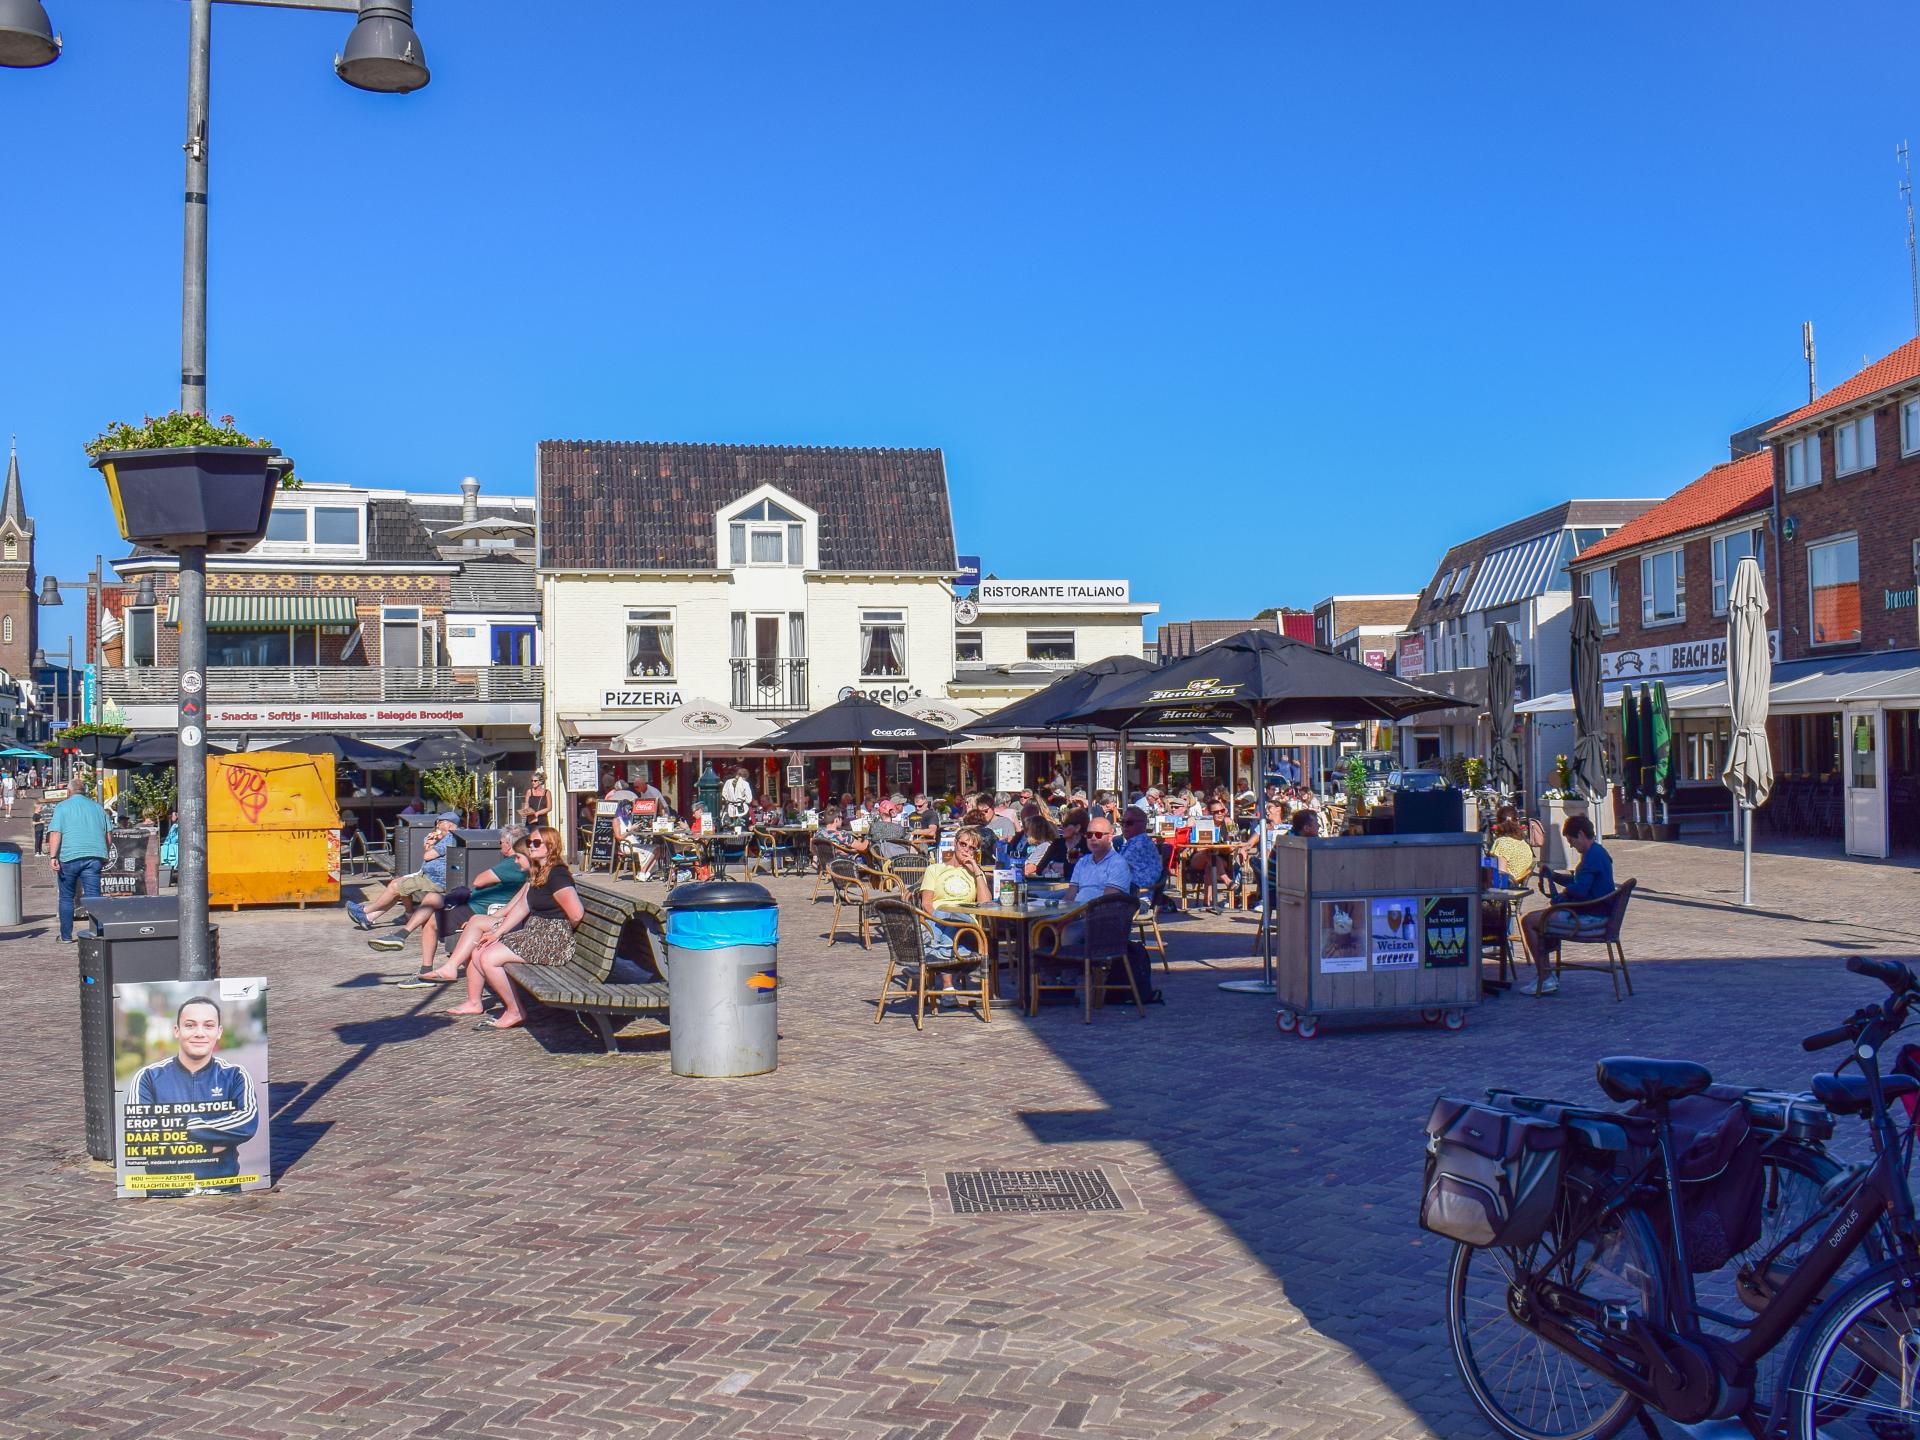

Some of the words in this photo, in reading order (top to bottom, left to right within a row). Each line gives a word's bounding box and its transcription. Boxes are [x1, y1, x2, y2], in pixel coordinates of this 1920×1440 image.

[1885, 589, 1917, 610] Brasseri
[1672, 644, 1709, 669] BEACH
[1148, 690, 1206, 702] Hertog
[1204, 686, 1236, 698] Jan
[221, 711, 258, 721] Snacks
[267, 711, 302, 722] Softijs
[311, 710, 367, 720] Milkshakes
[377, 710, 417, 721] Belegde
[419, 709, 464, 721] Broodjes
[1158, 710, 1207, 721] Hertog
[871, 727, 917, 738] Coca-Cola
[1377, 940, 1415, 950] Weizen
[126, 1104, 150, 1115] MET
[154, 1103, 171, 1114] DE
[173, 1100, 236, 1114] ROLSTOEL
[126, 1118, 158, 1129] EROP
[161, 1117, 184, 1128] UIT.
[126, 1132, 160, 1142] DAAR
[163, 1131, 188, 1141] DOE
[127, 1146, 139, 1156] IK
[142, 1145, 167, 1155] HET
[170, 1144, 207, 1154] VOOR.
